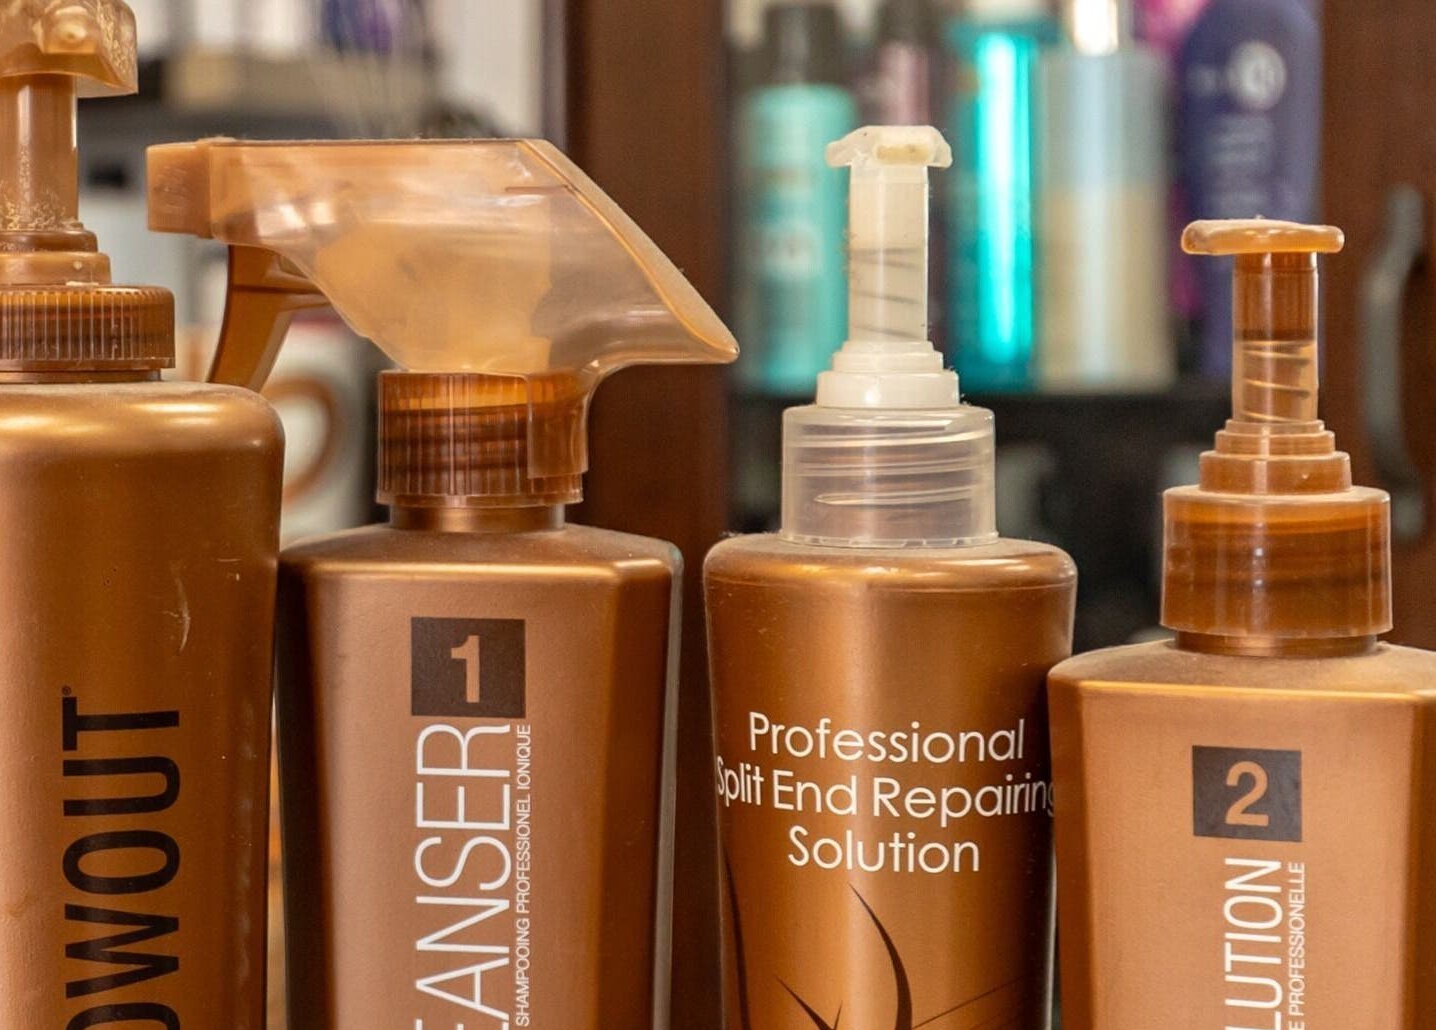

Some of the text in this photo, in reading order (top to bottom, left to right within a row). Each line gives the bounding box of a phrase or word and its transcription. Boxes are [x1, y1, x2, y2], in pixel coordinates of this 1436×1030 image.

[450, 635, 480, 703] 1
[749, 711, 1024, 763] Professional
[716, 755, 764, 807] Split
[772, 770, 857, 816] End
[1224, 761, 1269, 827] 2
[516, 724, 532, 1027] SHAMPOOING PROFESSIONEL IONIQUE
[788, 825, 979, 873] Solution
[1288, 862, 1306, 1016] PROFESSIONELLE
